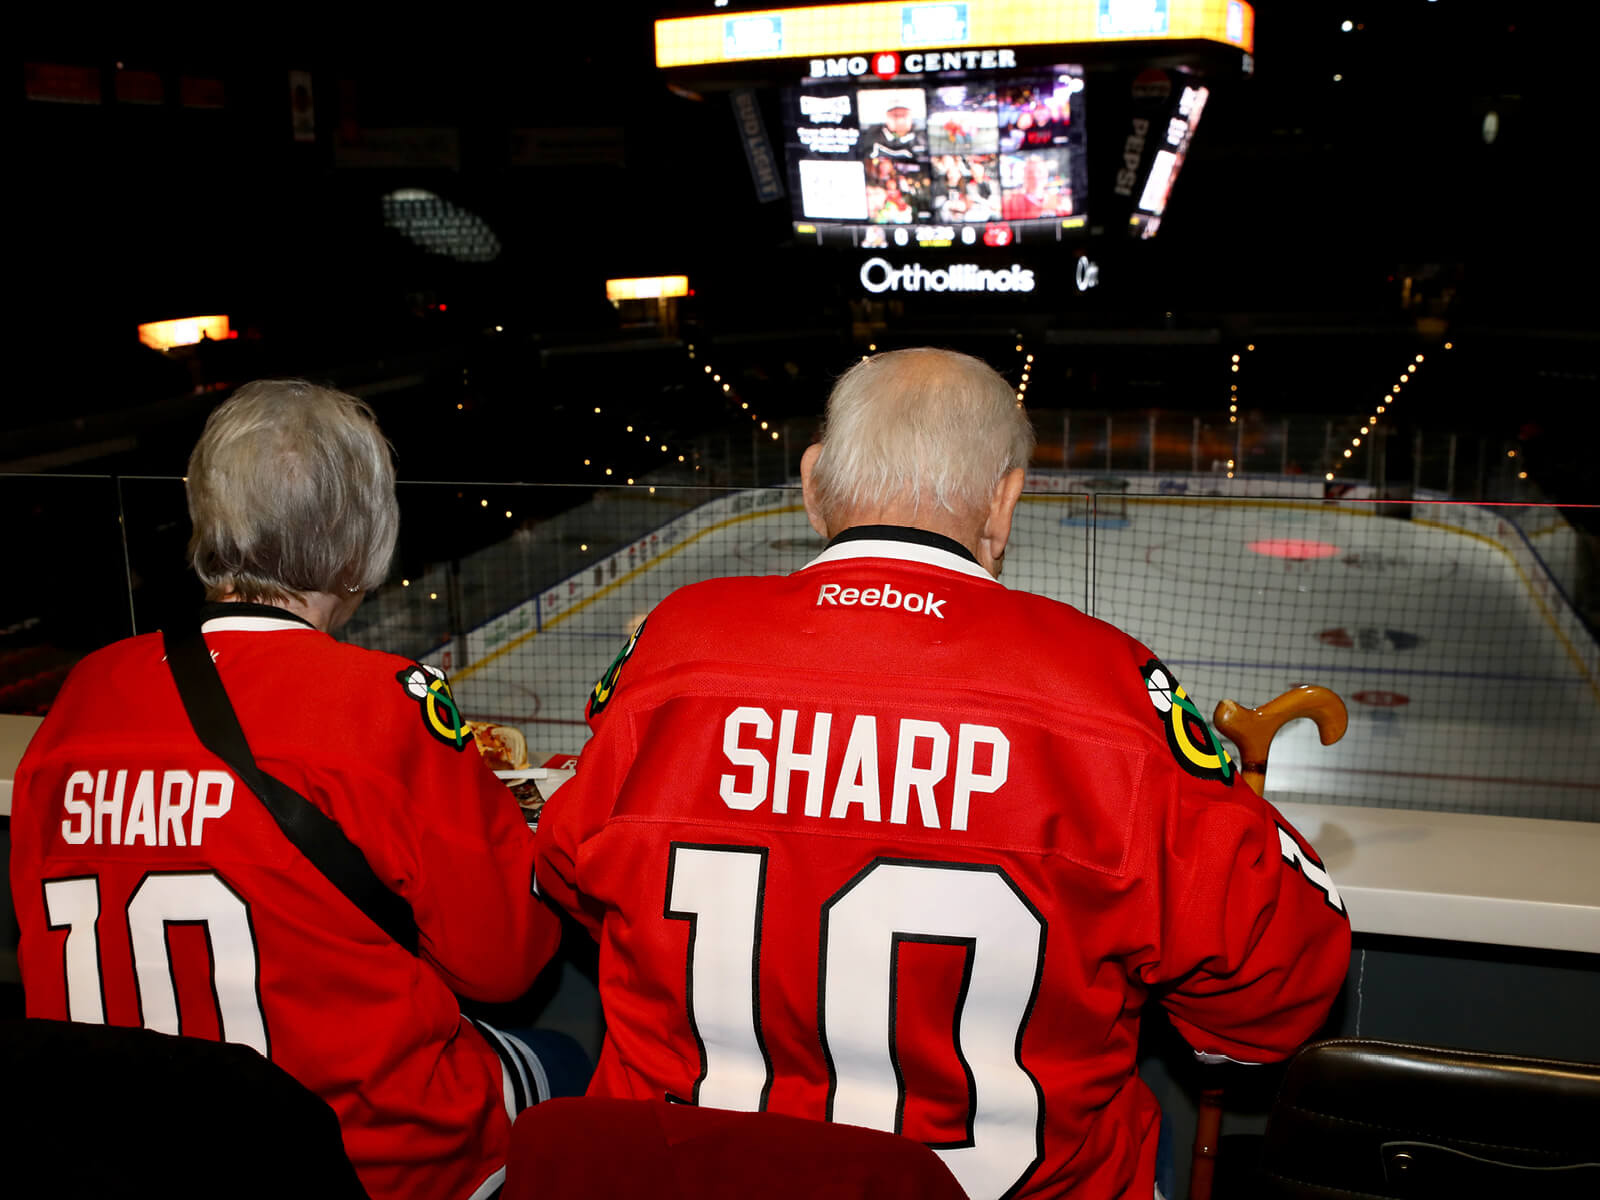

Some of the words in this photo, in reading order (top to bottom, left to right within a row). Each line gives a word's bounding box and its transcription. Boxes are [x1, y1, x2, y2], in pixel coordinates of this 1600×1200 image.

[810, 57, 868, 78] BMO
[905, 49, 1016, 73] CENTER
[1114, 118, 1149, 196] PEPSI
[816, 583, 947, 619] Reebok
[719, 706, 1010, 831] SHARP
[61, 769, 235, 847] SHARP
[41, 868, 272, 1062] 10
[664, 841, 1048, 1200] 10
